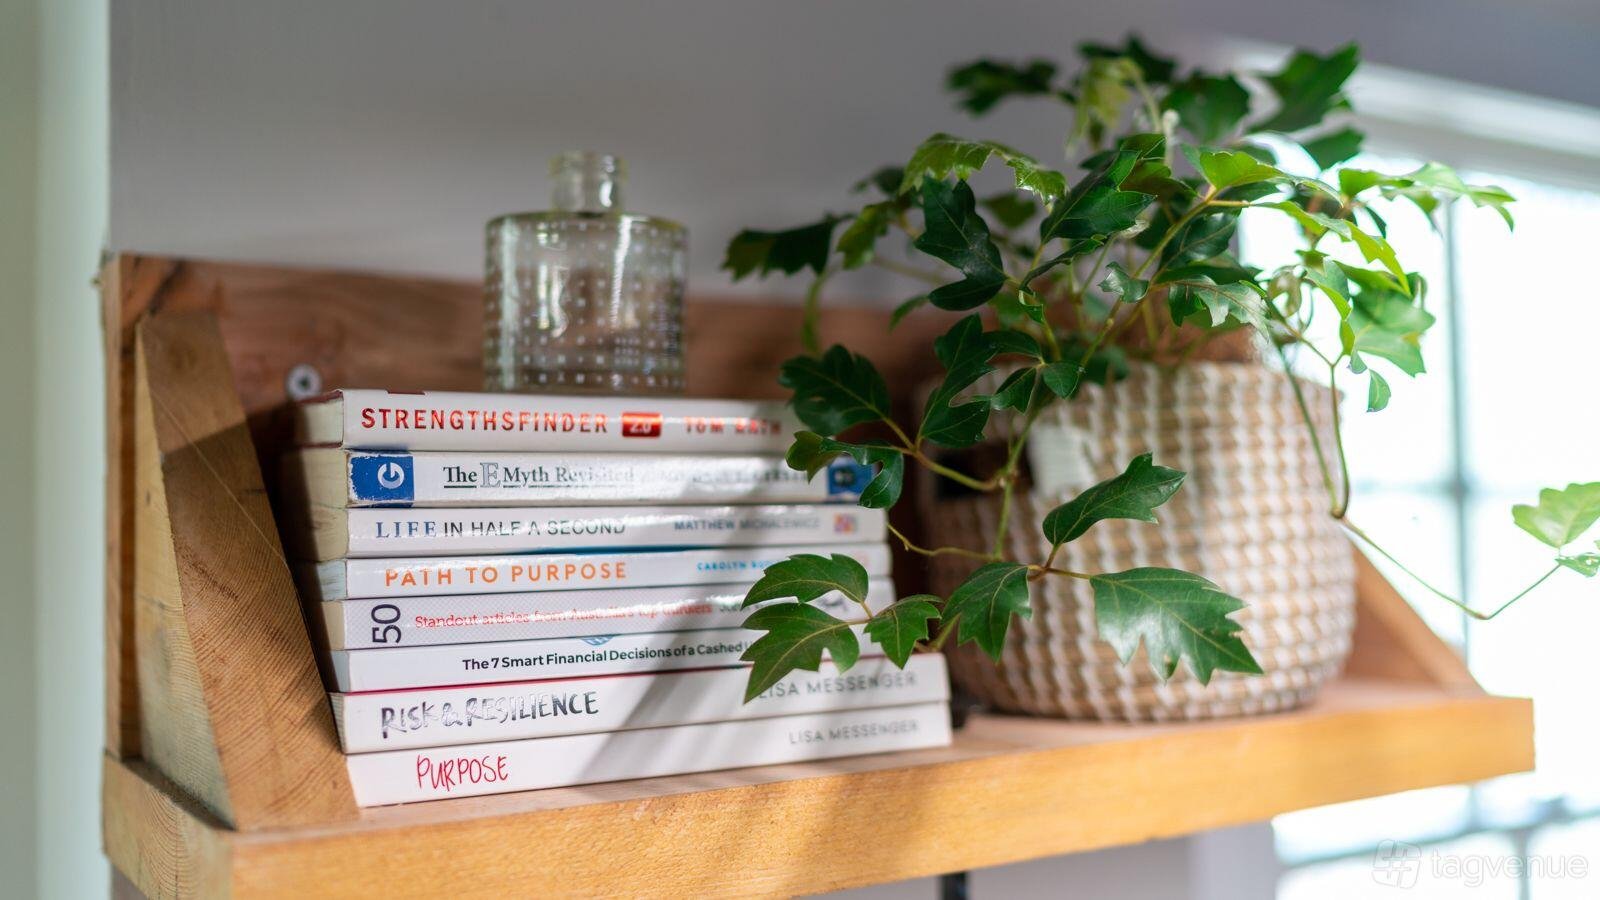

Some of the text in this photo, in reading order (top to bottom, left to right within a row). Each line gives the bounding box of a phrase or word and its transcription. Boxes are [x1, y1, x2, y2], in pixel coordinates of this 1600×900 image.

[361, 407, 608, 433] STRENGTHSFINDER
[629, 420, 652, 434] 2.0
[684, 416, 724, 433] TOM
[443, 466, 477, 483] The
[480, 462, 500, 487] E
[503, 464, 549, 487] Myth
[376, 519, 626, 538] LIFE IN HALF A SECOND
[674, 518, 735, 530] MATTHEW
[385, 562, 627, 587] PATH TO PURPOSE
[371, 604, 402, 643] 50
[415, 614, 478, 628] Standout
[482, 611, 529, 625] articles
[462, 657, 489, 670] The
[491, 657, 499, 669] 7
[502, 654, 544, 667] Smart
[546, 650, 607, 665] Financial
[609, 646, 672, 660] Decisions
[673, 645, 687, 657] of
[688, 648, 695, 656] a
[697, 641, 742, 655] Cashed
[807, 673, 917, 695] MESSENGER
[381, 701, 435, 738] RISK
[466, 691, 600, 727] RESILIENCE
[788, 719, 919, 745] LISA MESSENGER
[417, 754, 509, 791] PURPOSE
